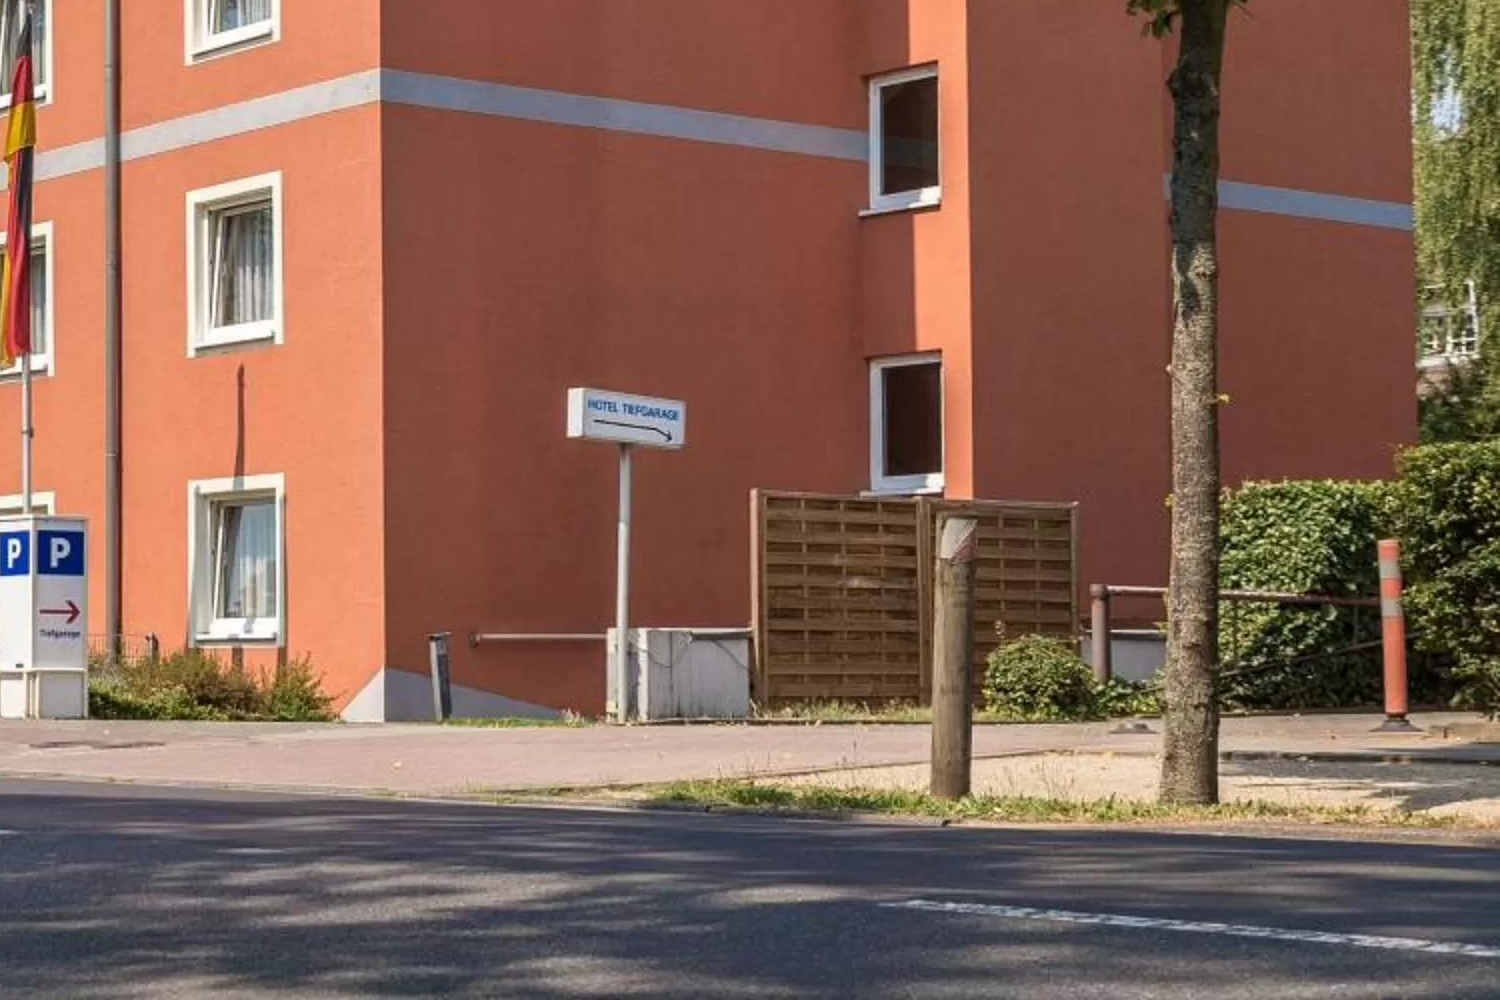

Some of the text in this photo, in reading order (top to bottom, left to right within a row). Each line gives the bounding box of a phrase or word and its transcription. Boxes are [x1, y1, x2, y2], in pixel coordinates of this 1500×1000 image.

[587, 399, 618, 414] HOTEL
[7, 538, 22, 569] P
[51, 538, 71, 569] P
